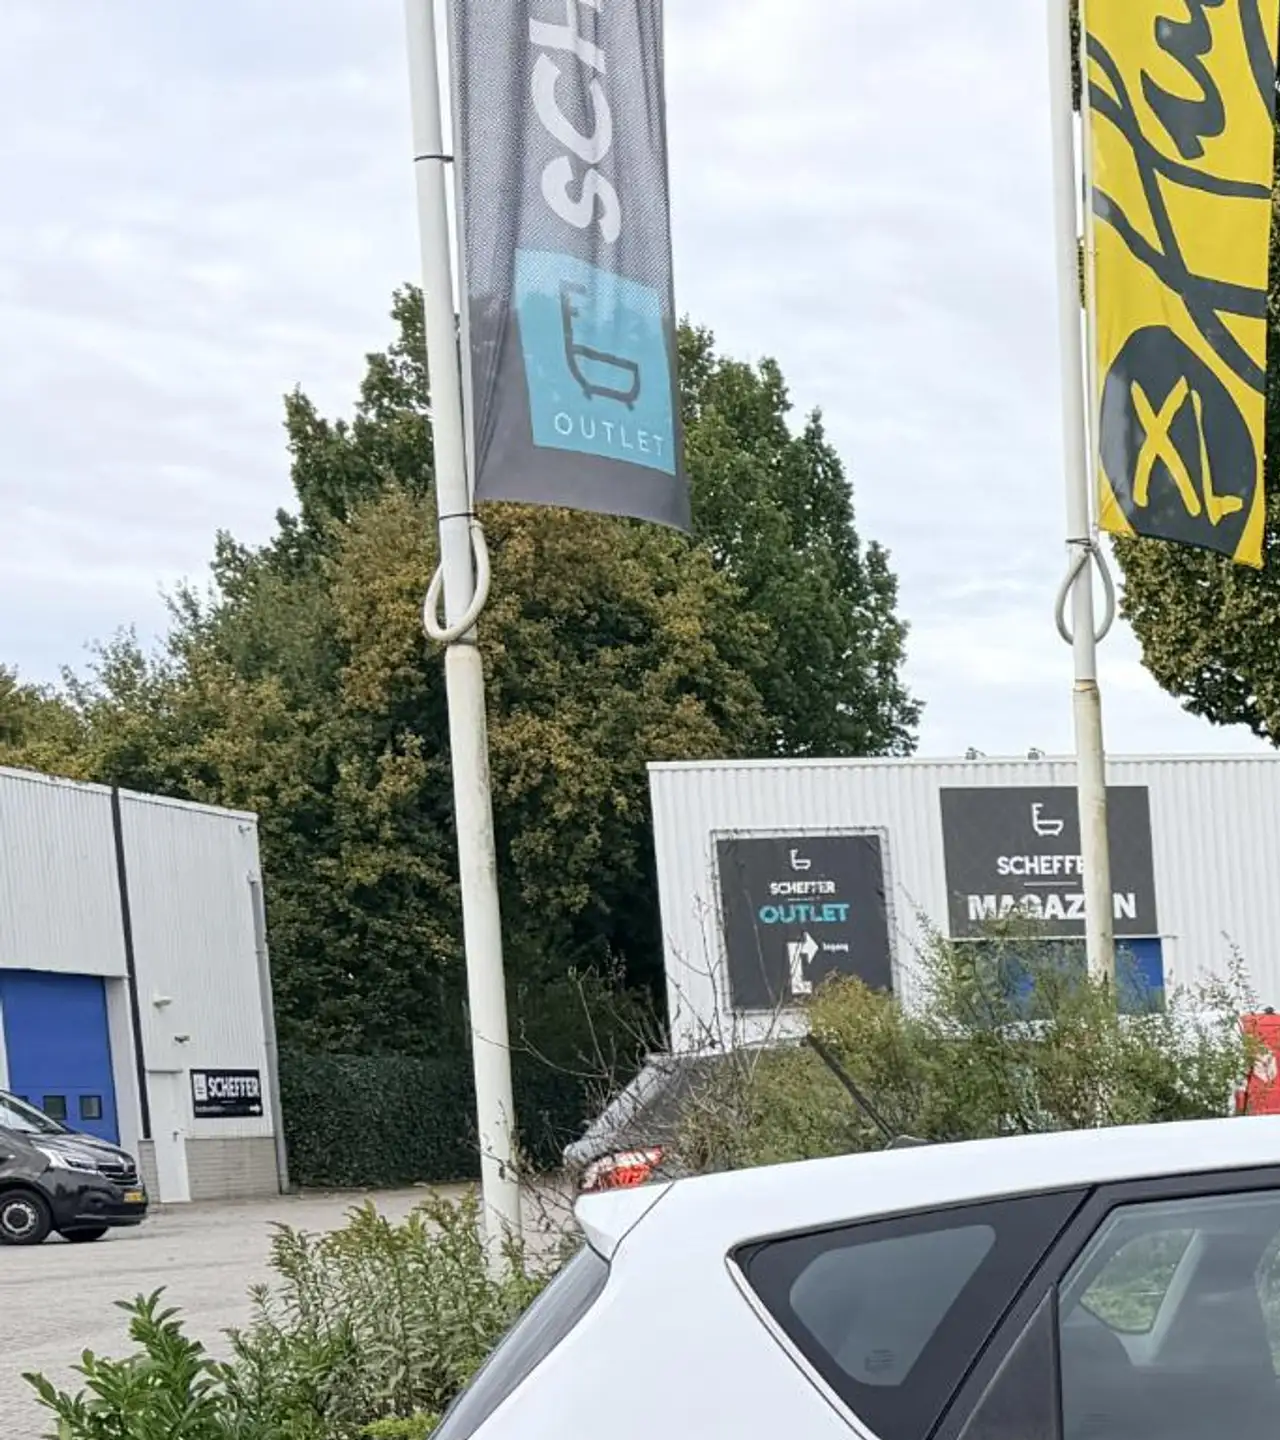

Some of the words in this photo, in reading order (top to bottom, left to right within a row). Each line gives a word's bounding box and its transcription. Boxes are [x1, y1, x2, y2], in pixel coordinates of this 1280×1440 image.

[554, 411, 664, 456] OUTLET
[1130, 375, 1243, 526] XL
[996, 855, 1086, 875] SCHEFFE
[769, 880, 836, 896] SCHEFFER
[759, 903, 850, 924] OUTLET
[967, 892, 1138, 921] MAGAZN
[208, 1076, 260, 1098] SCHEFFER
